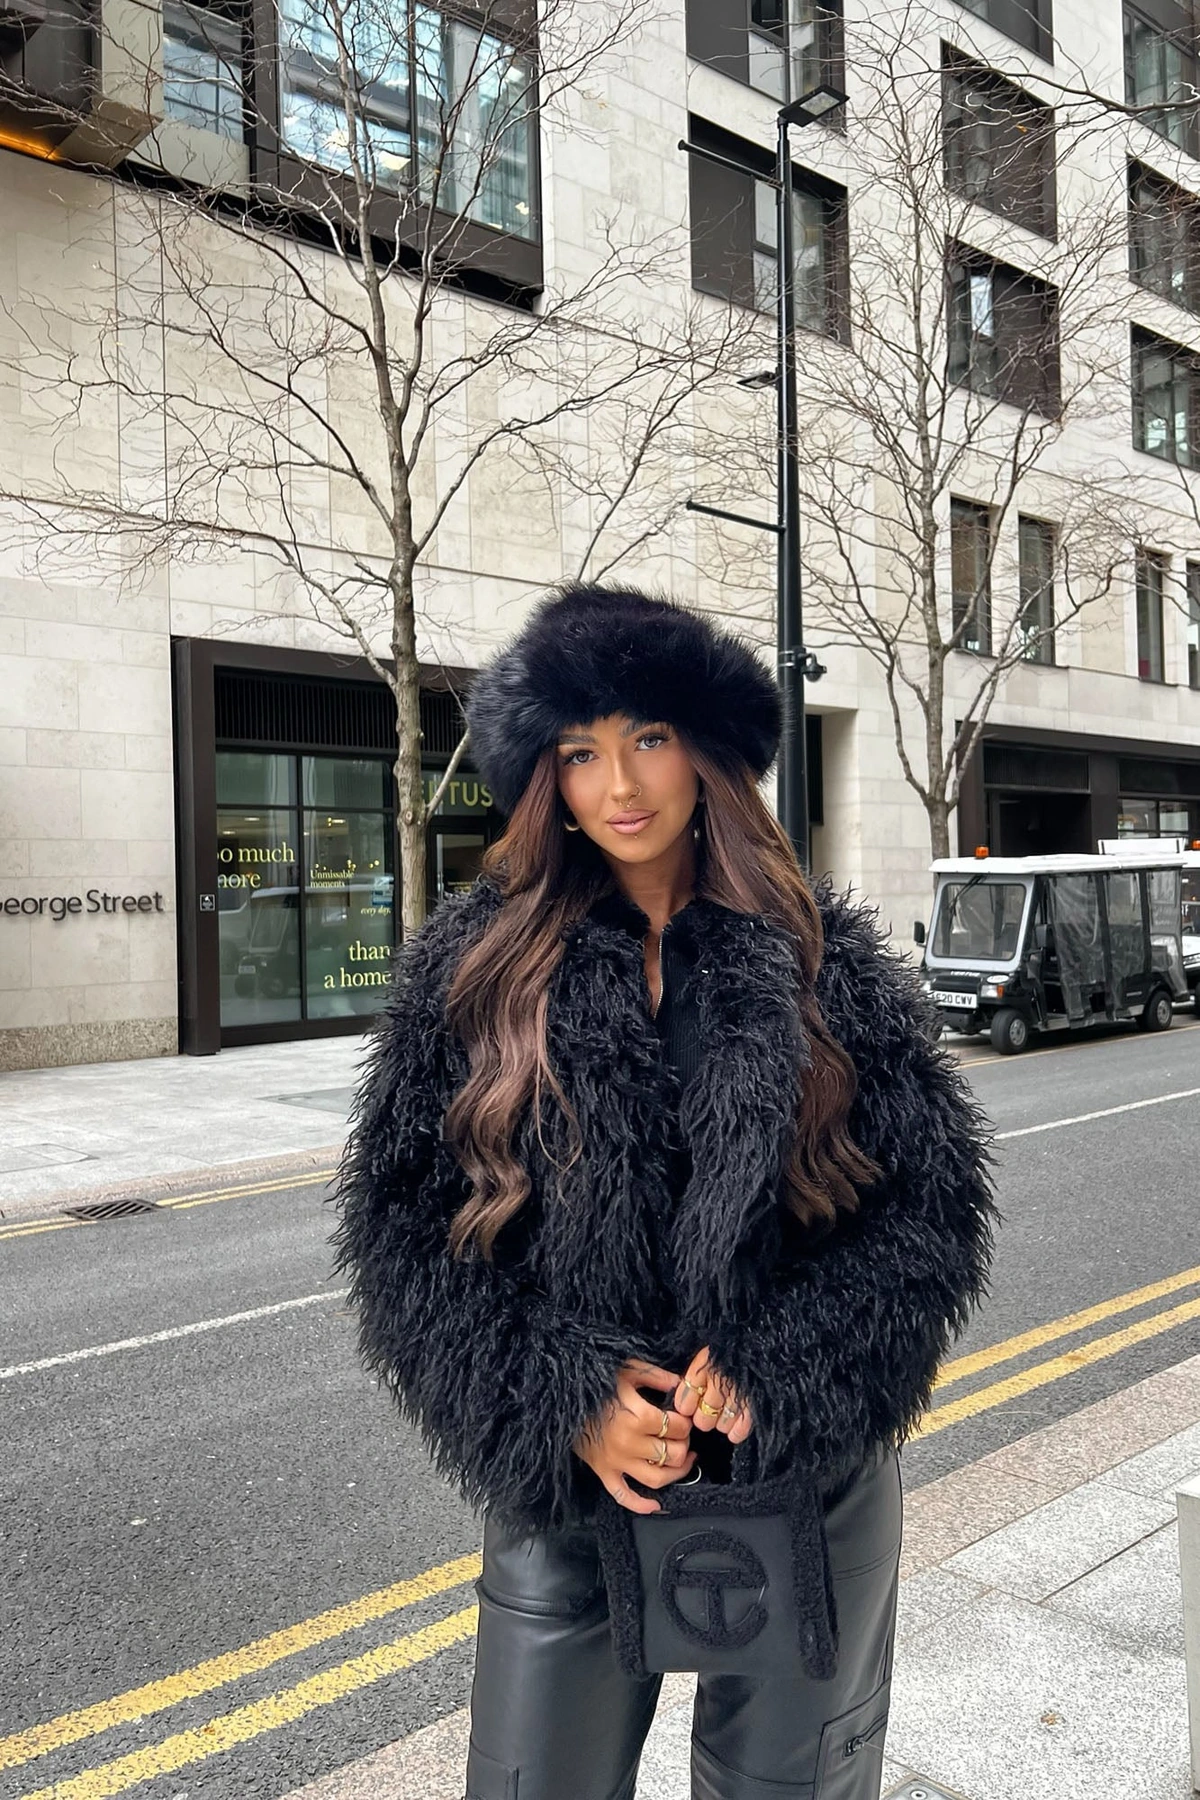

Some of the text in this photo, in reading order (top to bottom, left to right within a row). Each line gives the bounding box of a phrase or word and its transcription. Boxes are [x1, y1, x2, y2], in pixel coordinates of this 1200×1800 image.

[217, 841, 295, 863] o much
[310, 869, 355, 879] Unmissable
[310, 880, 346, 888] moments
[0, 889, 164, 921] eorge Street
[348, 940, 391, 961] than
[324, 967, 392, 989] a home
[955, 994, 973, 1006] CWV
